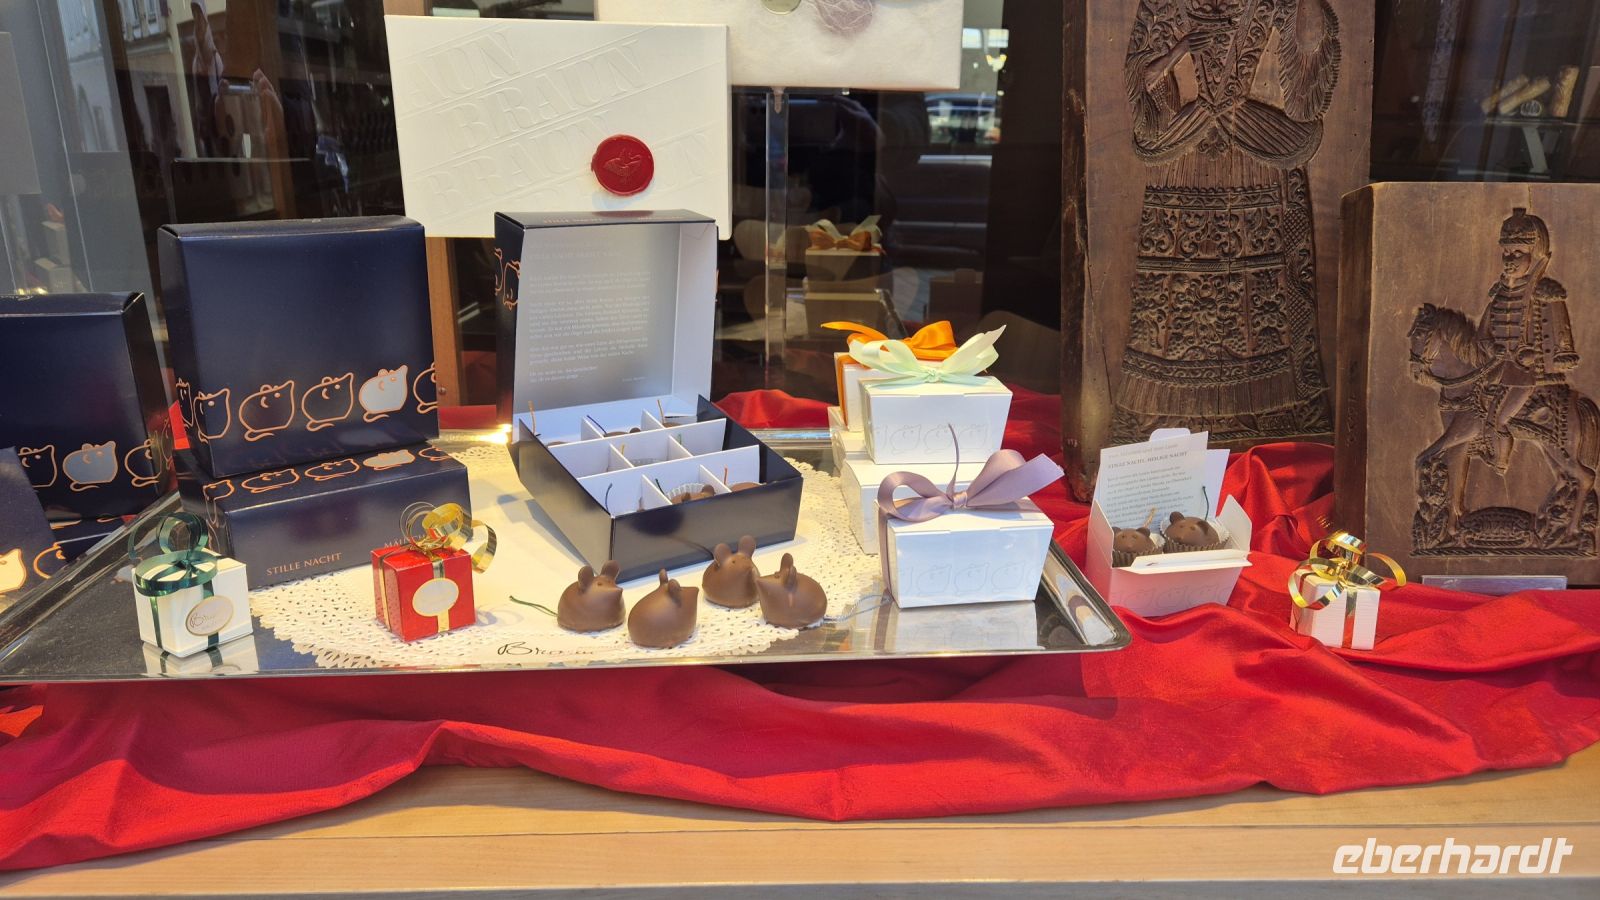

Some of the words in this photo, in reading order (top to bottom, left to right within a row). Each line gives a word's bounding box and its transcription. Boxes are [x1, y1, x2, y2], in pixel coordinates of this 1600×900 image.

[436, 39, 648, 154] BRAUN
[1170, 451, 1187, 459] NACHT
[266, 563, 301, 576] STILLE
[304, 552, 342, 568] NACHT
